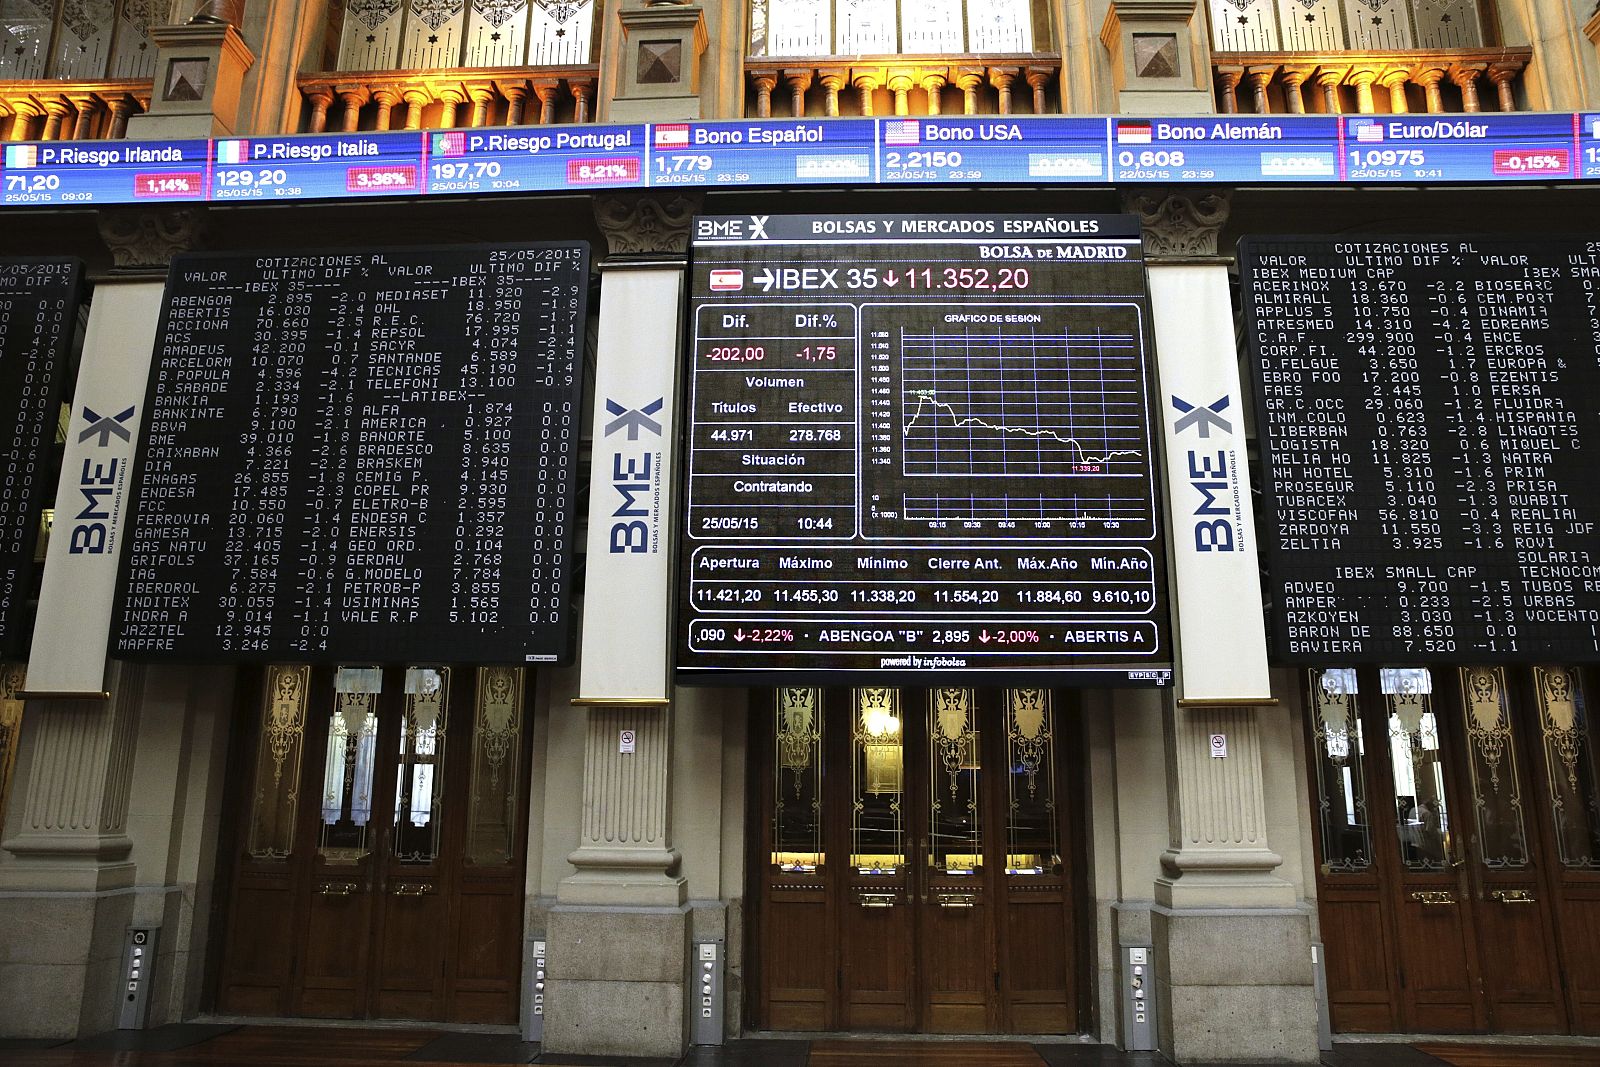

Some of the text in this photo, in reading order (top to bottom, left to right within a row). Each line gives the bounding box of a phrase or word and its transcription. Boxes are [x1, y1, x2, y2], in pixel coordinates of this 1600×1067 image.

[695, 125, 822, 146] Bono Español
[926, 125, 1022, 140] Bono USA
[1158, 123, 1279, 139] Bono Alemán
[1389, 121, 1488, 138] Euro/Dólar
[471, 130, 630, 153] P.Riesgo Portugal
[255, 140, 378, 161] P.Riesgo Italia
[43, 147, 182, 167] P.Riesgo Irlanda
[886, 152, 962, 172] 2,2150
[1119, 151, 1184, 172] 0,608
[1350, 150, 1424, 169] 1,0975
[656, 156, 712, 174] 1,779
[1502, 157, 1560, 170] -0,15%
[432, 162, 501, 181] 197,70
[887, 171, 937, 179] 23/05/15
[1352, 169, 1401, 177] 25/05/15
[6, 175, 59, 193] 71,20
[217, 170, 286, 188] 129,20
[656, 174, 706, 183] 23/05/15
[148, 179, 189, 193] 1,14%
[432, 180, 520, 190] 25/05/15 10:04
[6, 193, 51, 201] 25/05/15
[217, 189, 263, 197] 25/05/15
[698, 221, 743, 235] BME
[813, 218, 1098, 233] BOLSAS Y MERCADOS ESPAÑOLES
[979, 246, 1126, 258] BOLSA DE MADRID
[1335, 243, 1478, 253] COTIZACIONES AL
[490, 249, 580, 260] 25/05/2015
[1260, 256, 1306, 265] VALOR
[256, 255, 387, 268] COTIZACIONES AL
[1253, 269, 1394, 278] IBEX MEDIUM CAP
[776, 268, 1028, 292] IBEX 35 11.352,20
[1253, 281, 1406, 291] ACERINOX 13.670
[172, 294, 312, 306] ABENGOA 2.895
[376, 288, 522, 301] MEDIASET 11.920
[170, 306, 310, 318] ABERTIS 16.030
[945, 314, 987, 322] GRÁFICO
[1005, 314, 1040, 322] SESIÓN
[723, 315, 749, 327] Dif.
[796, 314, 836, 327] Dif.%
[1258, 320, 1411, 329] ATRESMED 14.310
[1481, 319, 1549, 329] EDREAMS
[372, 325, 519, 338] REPSOL 17.995
[707, 347, 764, 362] -202,00
[797, 347, 835, 362] -1,75
[367, 377, 514, 389] TELEFONI 13.100
[746, 377, 803, 387] Volumen
[1492, 385, 1541, 395] FERSA
[155, 395, 208, 406] BANKIA
[712, 402, 756, 413] Títulos
[789, 402, 842, 412] Efectivo
[151, 422, 186, 432] BBVA
[711, 430, 752, 441] 44.971
[790, 430, 841, 441] 278.768
[357, 457, 508, 468] BRASKEM 3.940
[742, 453, 804, 465] Situación
[1229, 450, 1237, 484] ESPAÑOLES
[112, 492, 121, 524] MERCADOS
[118, 458, 127, 490] ESPAÑOLES
[141, 486, 287, 498] ENDESA 17.485
[734, 481, 812, 492] Contratando
[1275, 481, 1434, 492] PROSEGUR 5.110
[1507, 481, 1556, 491] PRISA
[69, 458, 118, 554] BME
[610, 453, 651, 553] BME
[1188, 450, 1234, 552] BME
[1233, 486, 1241, 520] MERCADOS
[1278, 509, 1438, 520] VISCOFAN 56.810
[702, 518, 758, 529] 25/05/15
[798, 518, 832, 529] 10:44
[131, 555, 279, 565] GRIFOLS 37.165
[347, 554, 403, 565] GERDAU
[700, 557, 759, 570] Apertura
[780, 556, 832, 568] Máximo
[858, 557, 908, 568] Mínimo
[928, 558, 1002, 569] Cierre Ant.
[1018, 557, 1077, 569] Máx.Año
[1091, 557, 1147, 569] Mín.Año
[698, 589, 761, 603] 11.421,20
[774, 590, 838, 604] 11.455,30
[851, 590, 915, 604] 11.338,20
[934, 591, 998, 604] 11.554,20
[1017, 591, 1081, 604] 11.884,60
[1093, 591, 1149, 604] 9.610,10
[747, 630, 1144, 644] -2,22% ABENGOA "B" 2,895 -2,00% ABERTIS A
[118, 639, 268, 650] MAPFRE 3.246
[1290, 641, 1361, 652] BAVIERA
[881, 655, 966, 668] powered by infobolsa
